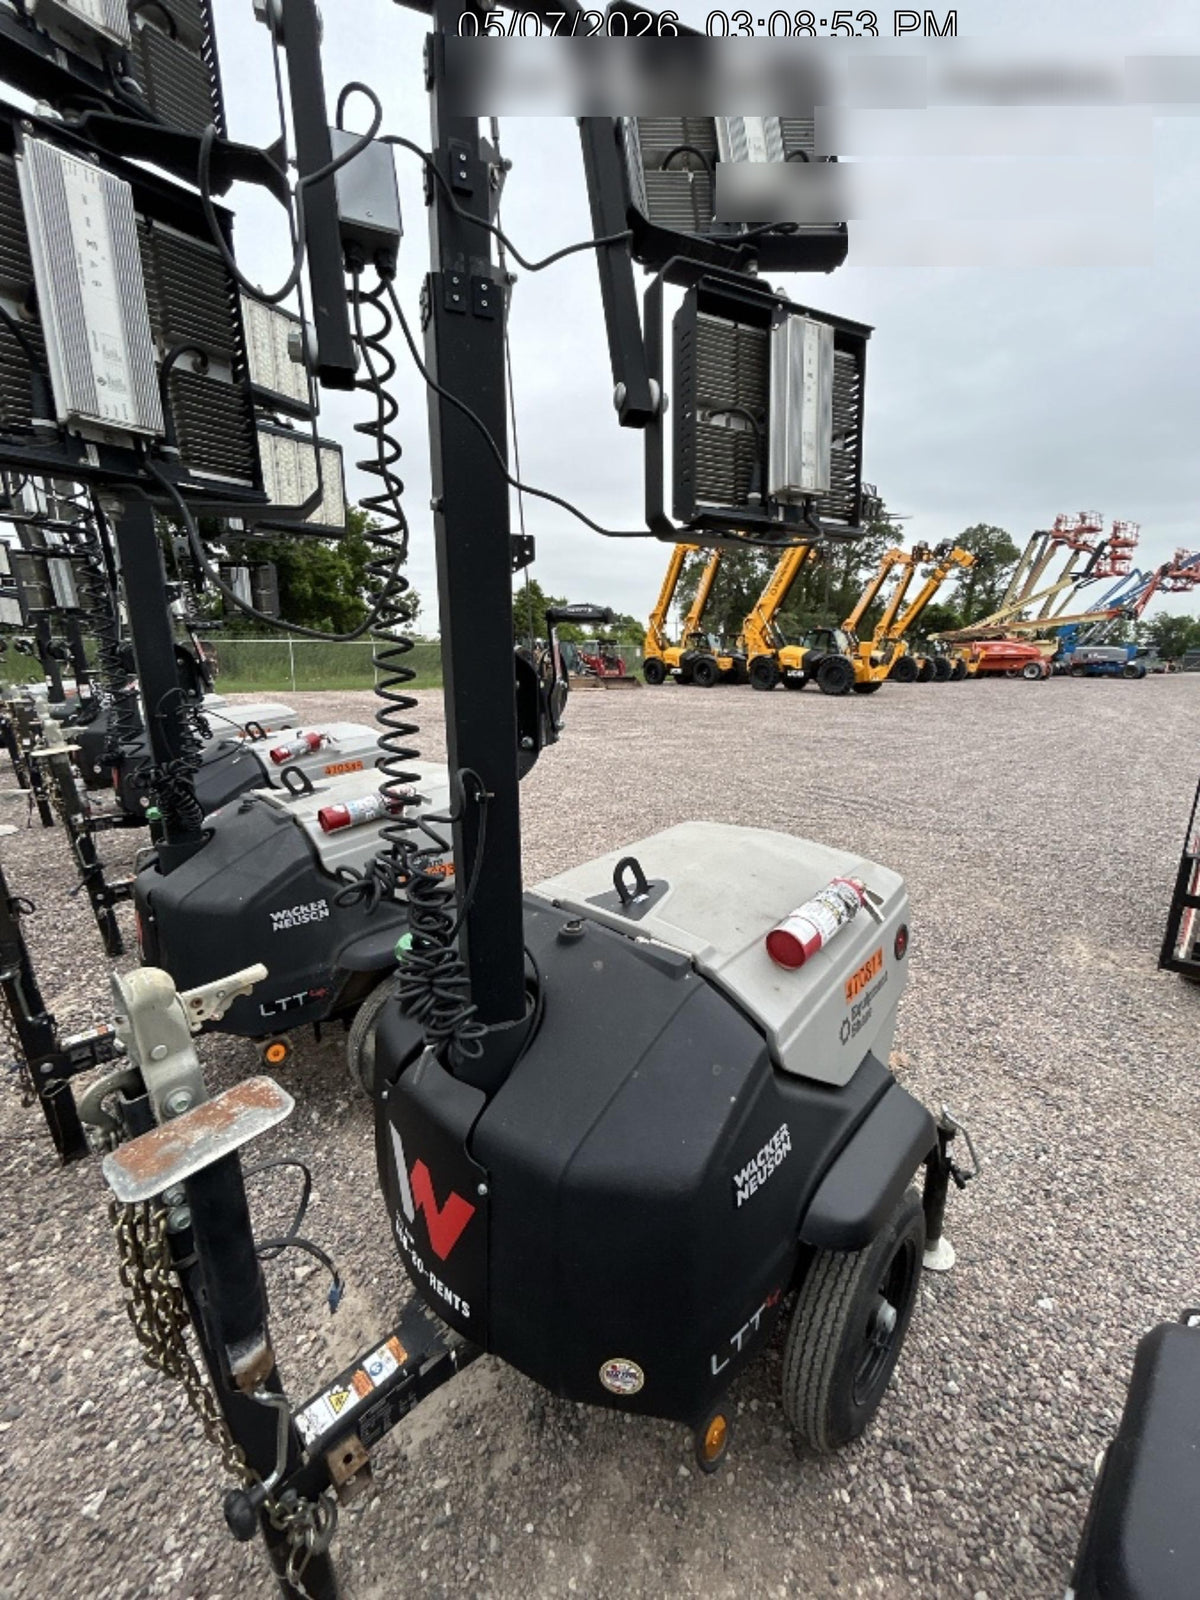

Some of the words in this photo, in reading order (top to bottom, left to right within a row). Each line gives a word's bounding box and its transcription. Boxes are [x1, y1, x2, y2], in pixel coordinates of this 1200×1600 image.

[269, 899, 328, 921] WACKER
[272, 908, 330, 932] NEUSON
[733, 1123, 790, 1188] WACKER
[737, 1135, 792, 1208] NEUSON
